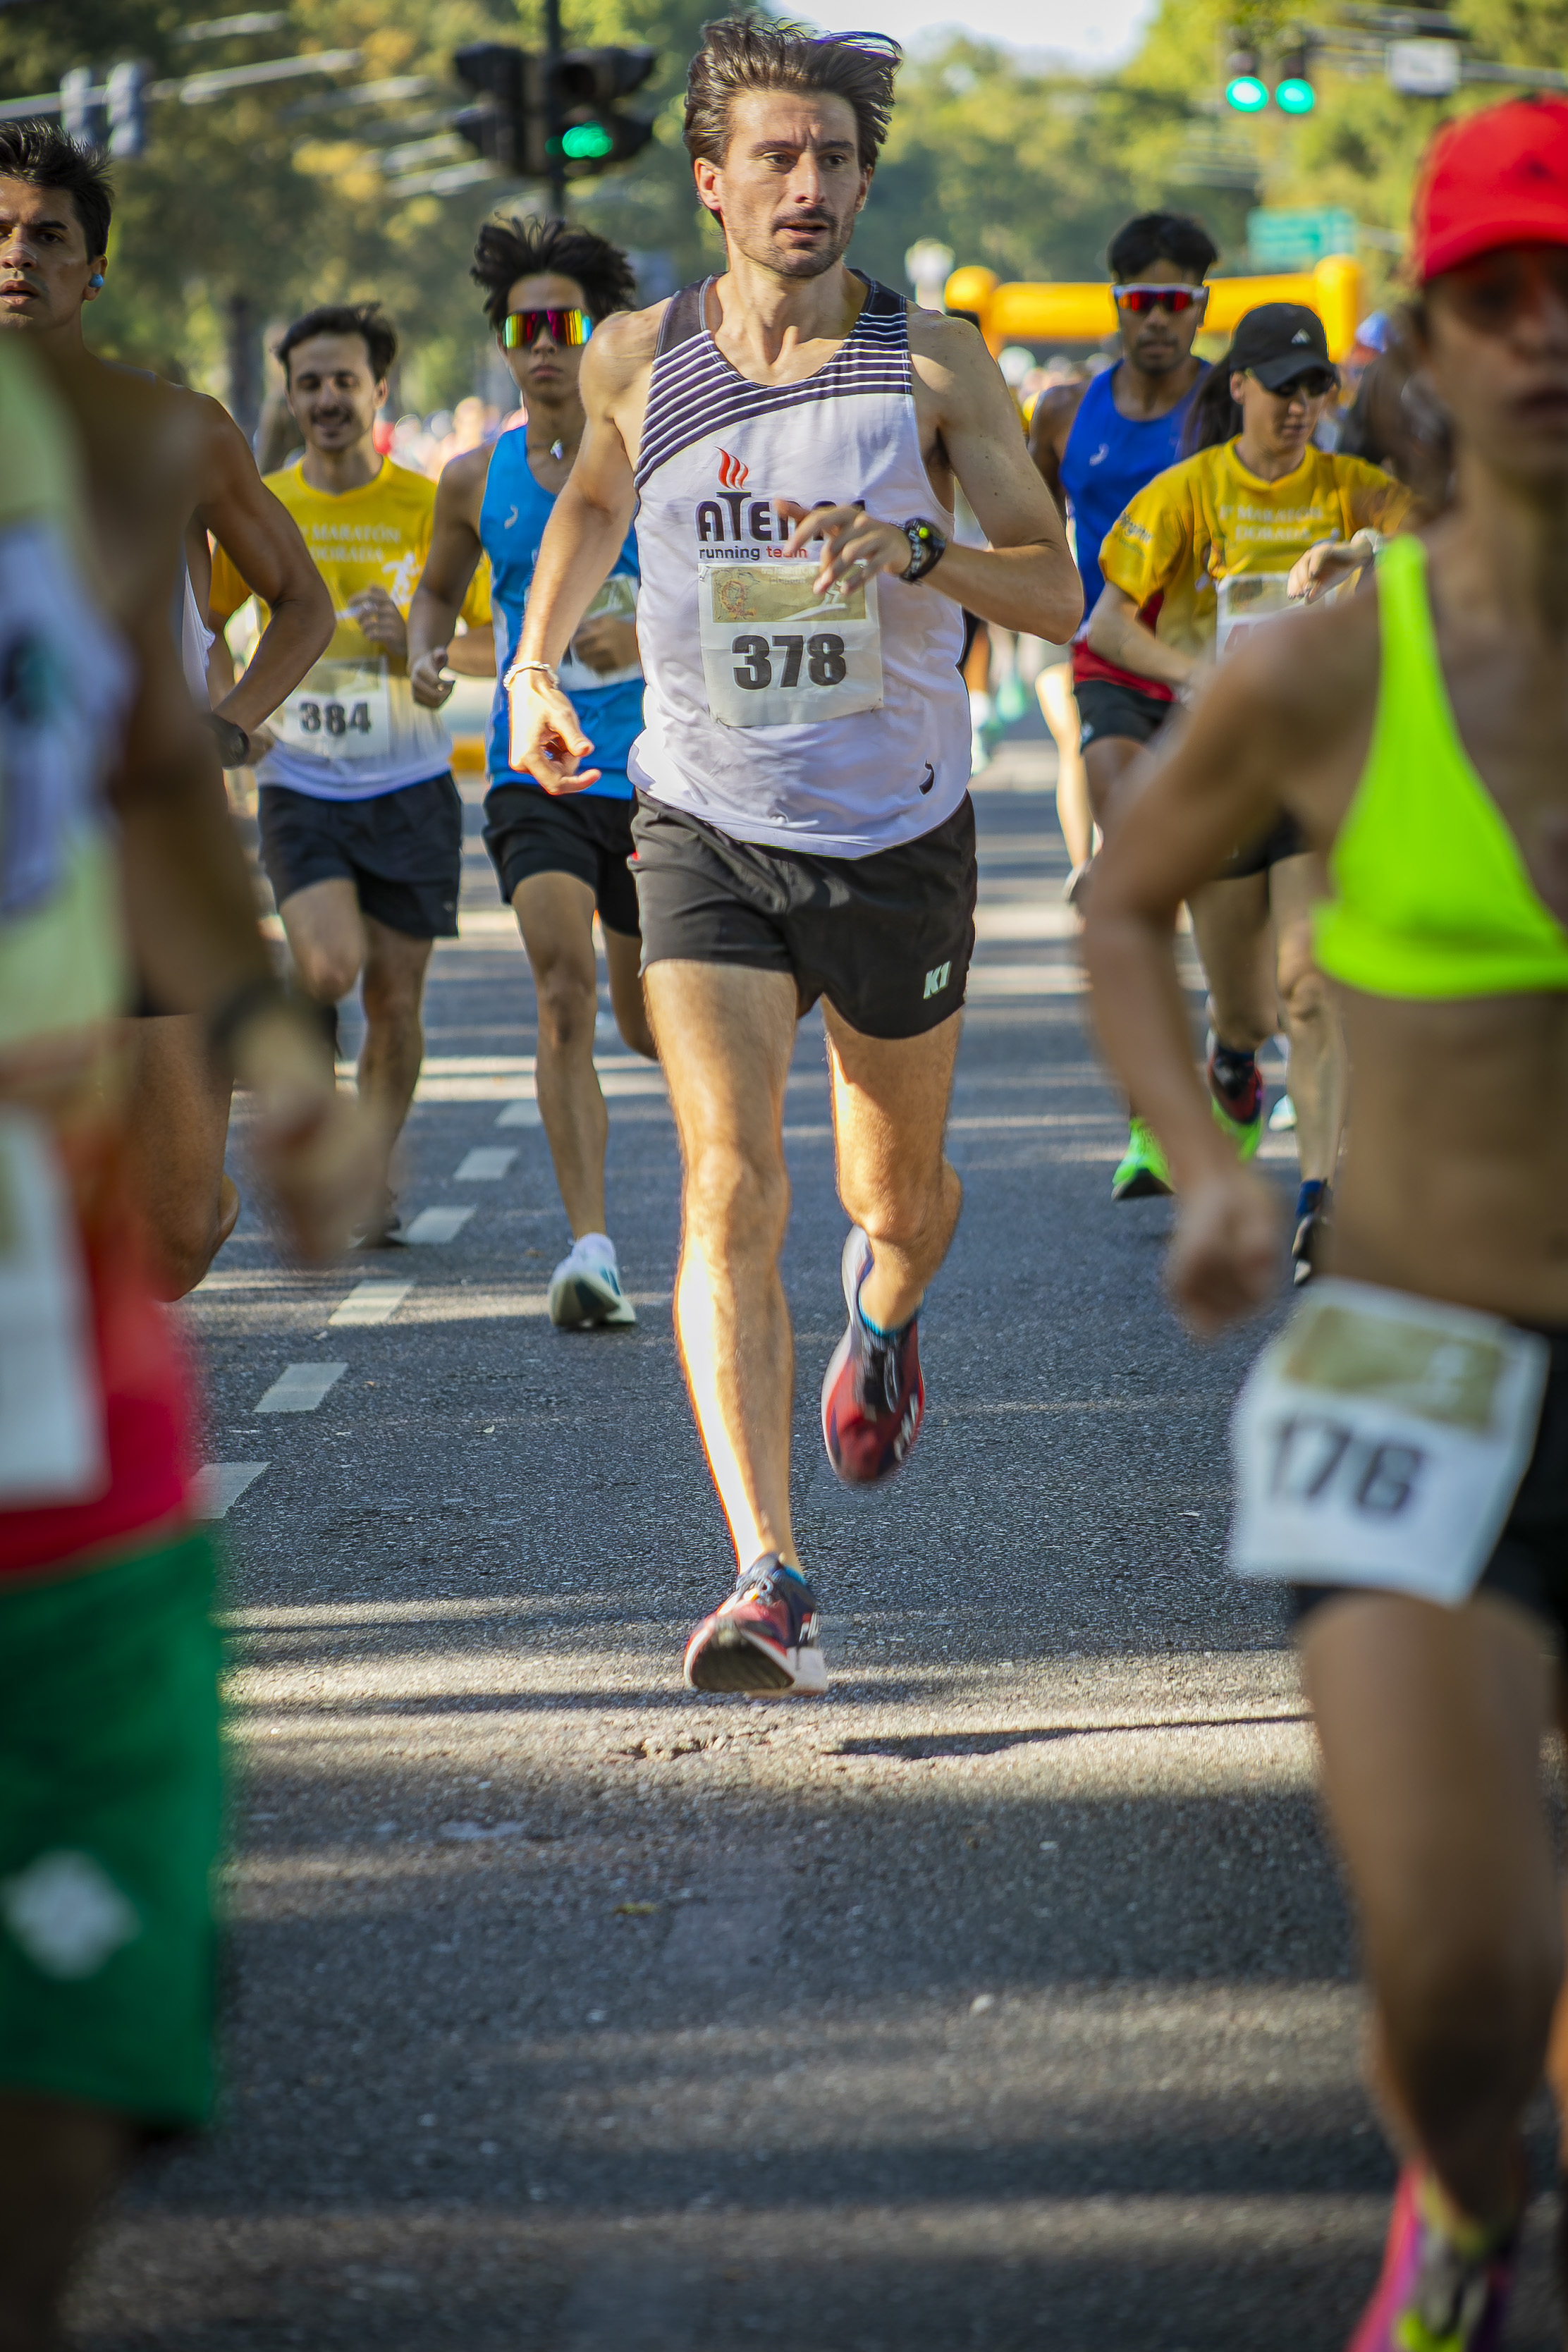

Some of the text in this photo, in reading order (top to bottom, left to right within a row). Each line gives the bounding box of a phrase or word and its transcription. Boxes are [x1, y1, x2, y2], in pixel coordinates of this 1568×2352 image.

[699, 545, 761, 561] running
[731, 633, 847, 690] 378
[299, 702, 372, 734] 384
